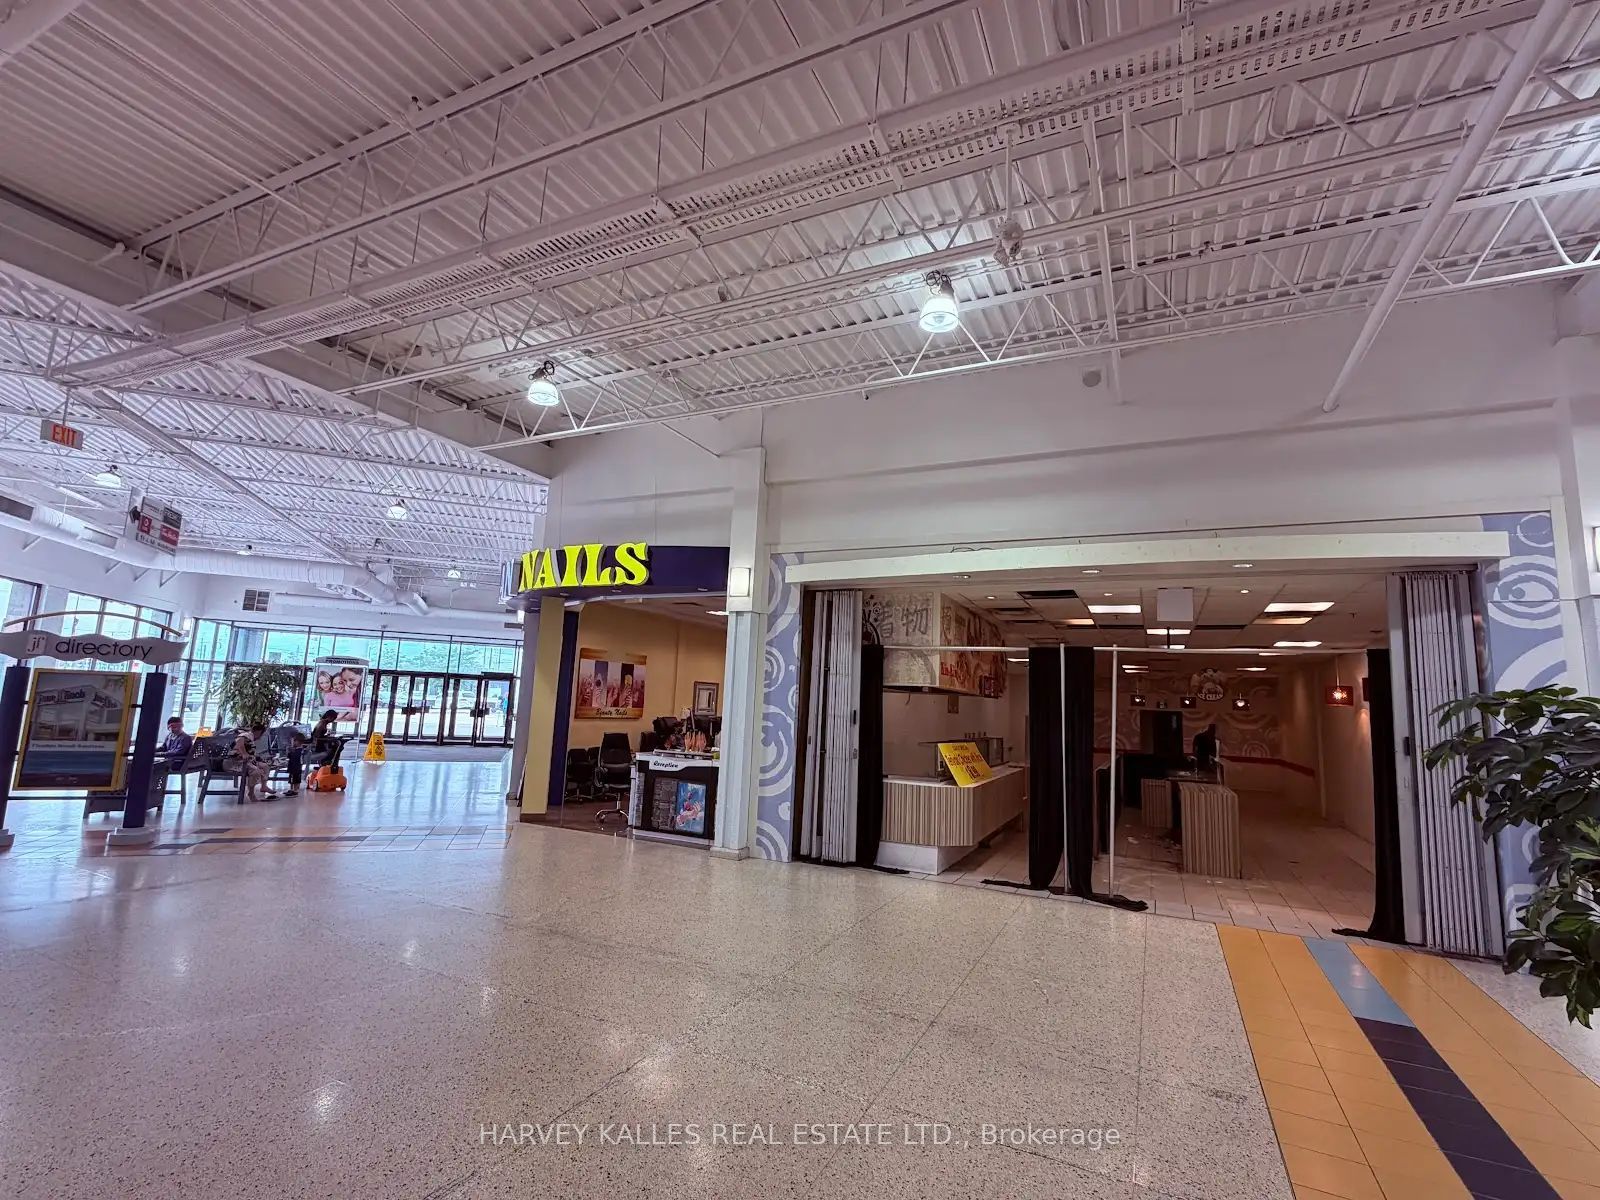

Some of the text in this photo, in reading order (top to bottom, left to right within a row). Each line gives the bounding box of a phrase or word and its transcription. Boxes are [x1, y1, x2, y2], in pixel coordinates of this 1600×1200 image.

[52, 424, 77, 448] EXIT
[518, 542, 648, 592] NAILS
[55, 639, 153, 660] directory
[653, 760, 679, 769] Reception
